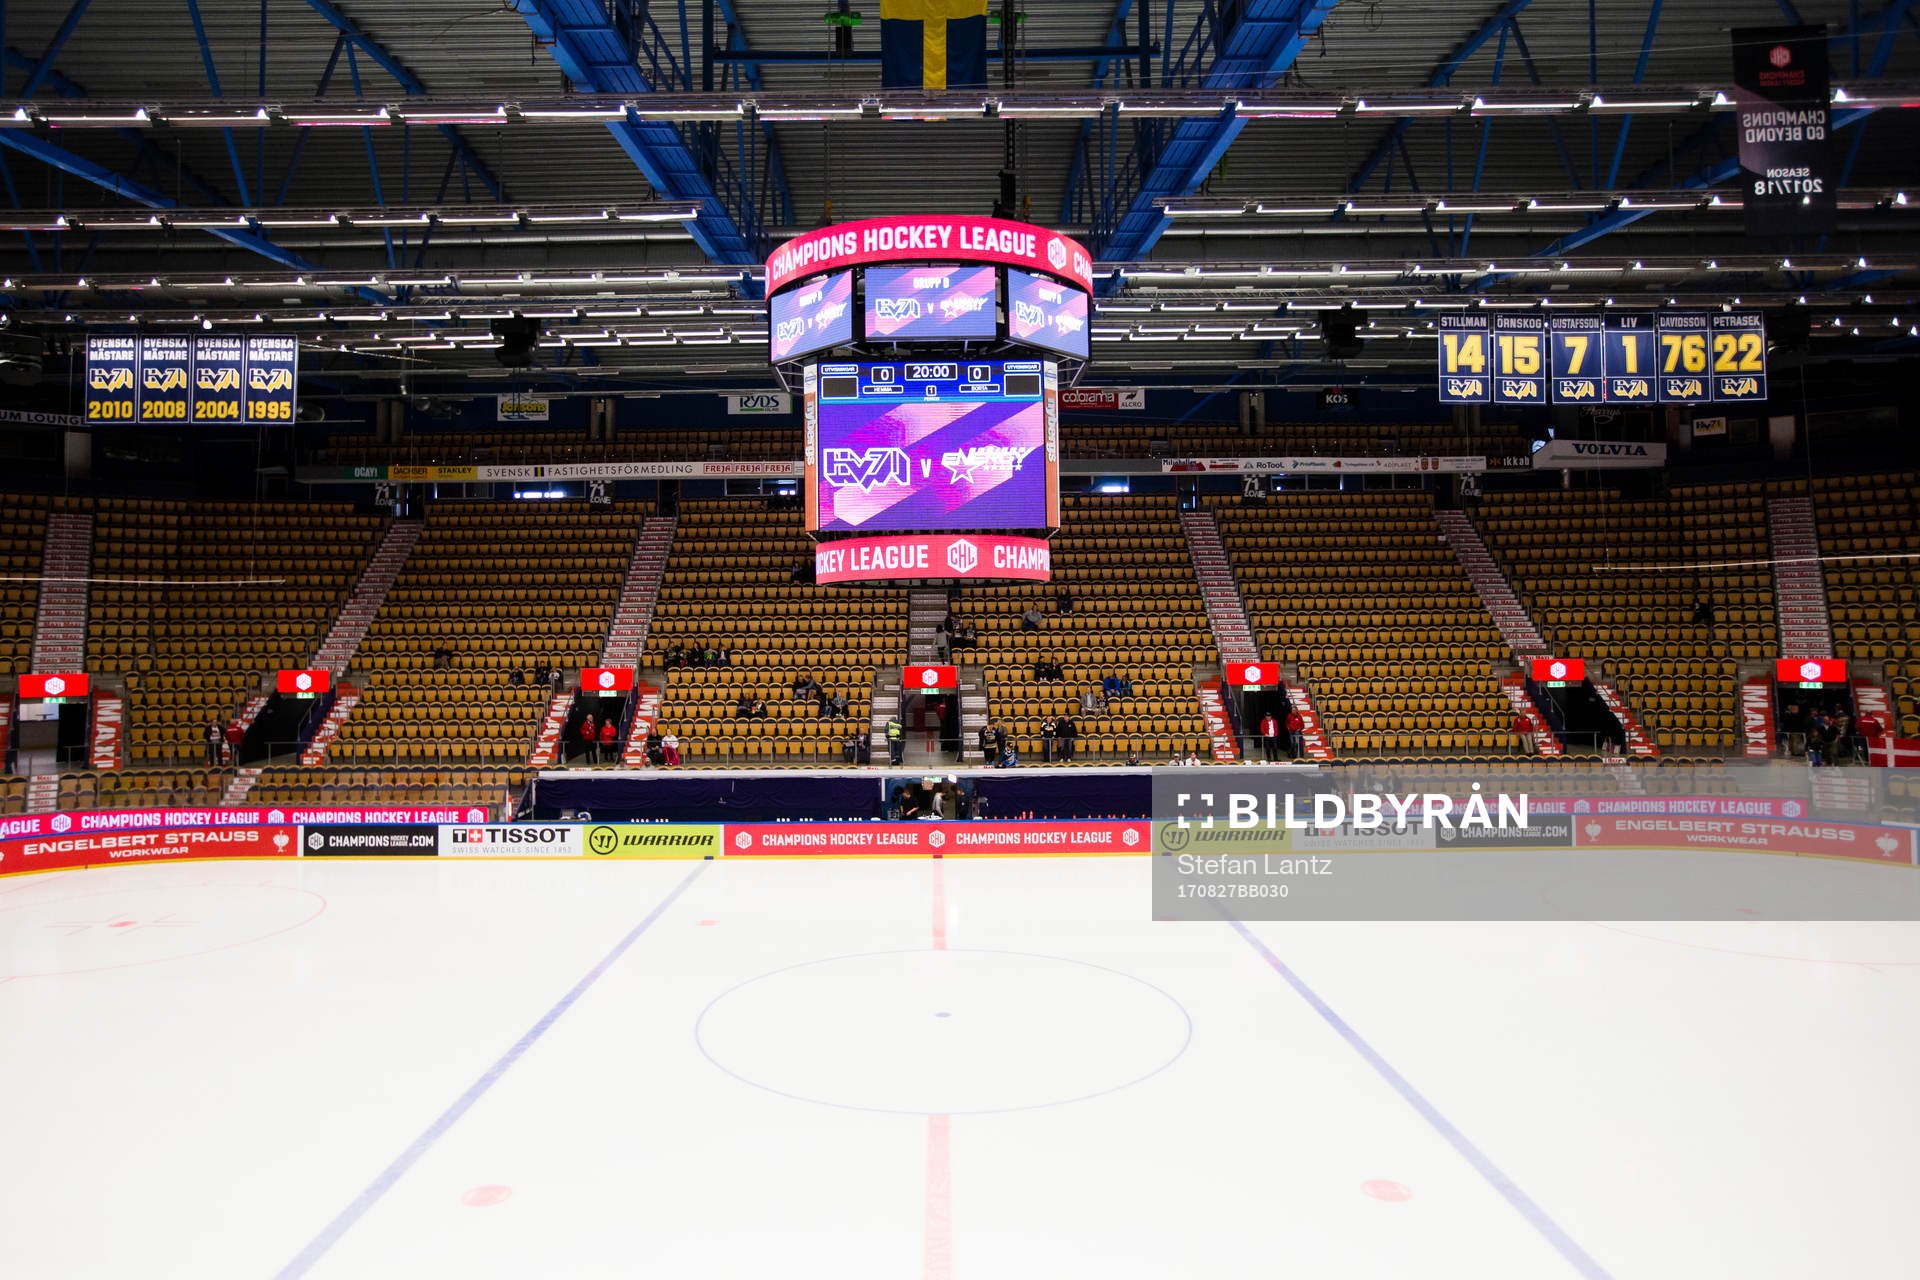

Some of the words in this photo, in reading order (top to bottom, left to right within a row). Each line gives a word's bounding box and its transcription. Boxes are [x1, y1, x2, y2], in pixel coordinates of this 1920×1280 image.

[772, 231, 857, 281] CHAMPIONS
[864, 225, 952, 253] HOCKEY
[960, 226, 1036, 258] LEAGUE
[1441, 316, 1486, 328] STILLMAN
[1497, 315, 1542, 329] ÖRNSKOG
[1552, 318, 1599, 329] GUSTAFSSON
[1621, 317, 1637, 328] LIV
[1660, 316, 1706, 328] DAVIDSSON
[1713, 315, 1760, 328] PETRASEK
[90, 338, 134, 348] SVENSKA
[144, 338, 188, 348] SVENSKA
[197, 338, 240, 348] SVENSKA
[250, 338, 294, 348] SVENSKA
[90, 348, 133, 361] MÄSTARE
[144, 348, 187, 361] MÄSTARE
[197, 348, 240, 361] MÄSTARE
[250, 348, 293, 361] MÄSTARE
[1444, 335, 1485, 373] 14
[1499, 336, 1540, 374] 15
[1564, 336, 1588, 374] 7
[1622, 336, 1638, 373] 1
[1662, 334, 1705, 372] 76
[1714, 334, 1762, 371] 22
[880, 369, 889, 380] 0
[912, 365, 950, 378] 20:00
[973, 368, 982, 379] 0
[740, 395, 779, 408] RYDS
[1062, 390, 1115, 402] colorama
[89, 401, 133, 418] 2010
[142, 401, 186, 418] 2008
[196, 401, 239, 418] 2004
[248, 401, 292, 419] 1995
[1572, 443, 1648, 456] VOLVIA
[487, 468, 530, 477] SVENSK
[548, 464, 693, 477] FASTIGHETSFÖRMEDLING
[823, 448, 911, 494] HV71
[1244, 478, 1260, 490] 71
[1460, 476, 1475, 488] 71
[375, 487, 389, 498] 71
[590, 485, 605, 496] 71
[850, 545, 928, 571] LEAGUE
[1528, 802, 1566, 814] EAGUE
[1598, 800, 1667, 813] CHAMPIONS
[1669, 800, 1716, 814] HOCKEY
[1720, 801, 1772, 815] LEAGUE
[81, 813, 161, 829] CHAMPIONS
[165, 813, 211, 825] HOCKEY
[215, 812, 260, 824] LEAGUE
[292, 811, 362, 823] CHAMPIONS
[365, 811, 411, 823] HOCKEY
[415, 811, 459, 823] LEAGUE
[486, 828, 570, 843] TISSOT
[1194, 830, 1286, 841] WARRIOR
[1462, 827, 1522, 838] CHAMPIONS
[1542, 826, 1567, 837] .COM
[1616, 820, 1737, 833] ENGELBERT
[1741, 823, 1855, 841] STRAUSS
[23, 834, 159, 856] ENGELBERT
[165, 831, 259, 844] STRAUSS
[329, 836, 389, 847] CHAMPIONS
[409, 836, 434, 847] .COM
[623, 835, 714, 846] WARRIOR
[762, 834, 827, 846] CHAMPIONS
[830, 833, 873, 846] HOCKEY
[876, 833, 918, 845] LEAGUE
[956, 832, 1020, 845] CHAMPIONS
[1024, 832, 1067, 844] HOCKEY
[1070, 832, 1112, 844] LEAGUE
[1687, 834, 1768, 845] WORKWEAR
[110, 847, 188, 858] WORKWEAR
